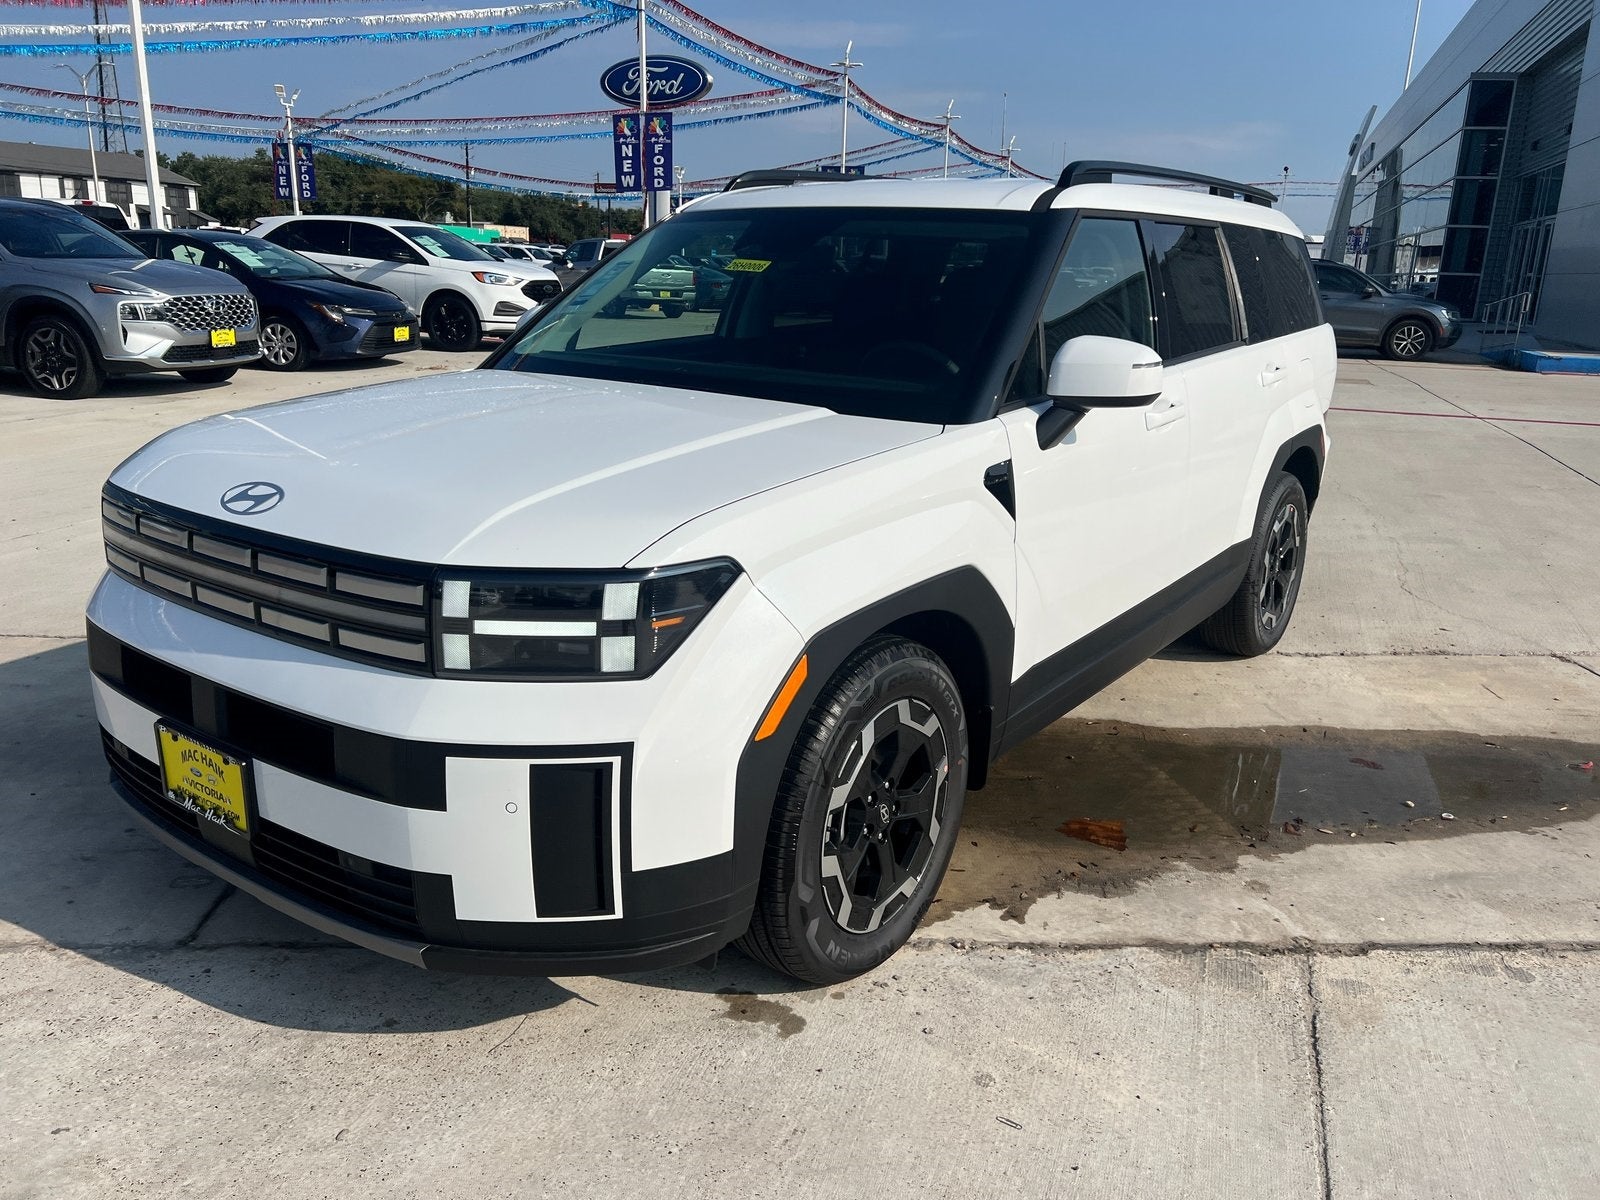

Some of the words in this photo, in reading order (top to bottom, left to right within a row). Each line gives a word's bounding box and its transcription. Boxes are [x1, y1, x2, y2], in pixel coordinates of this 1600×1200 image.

[278, 165, 289, 197] NEW
[301, 165, 311, 198] FORD
[621, 144, 635, 188] NEW
[653, 144, 665, 188] FORD
[181, 749, 199, 763] MAC
